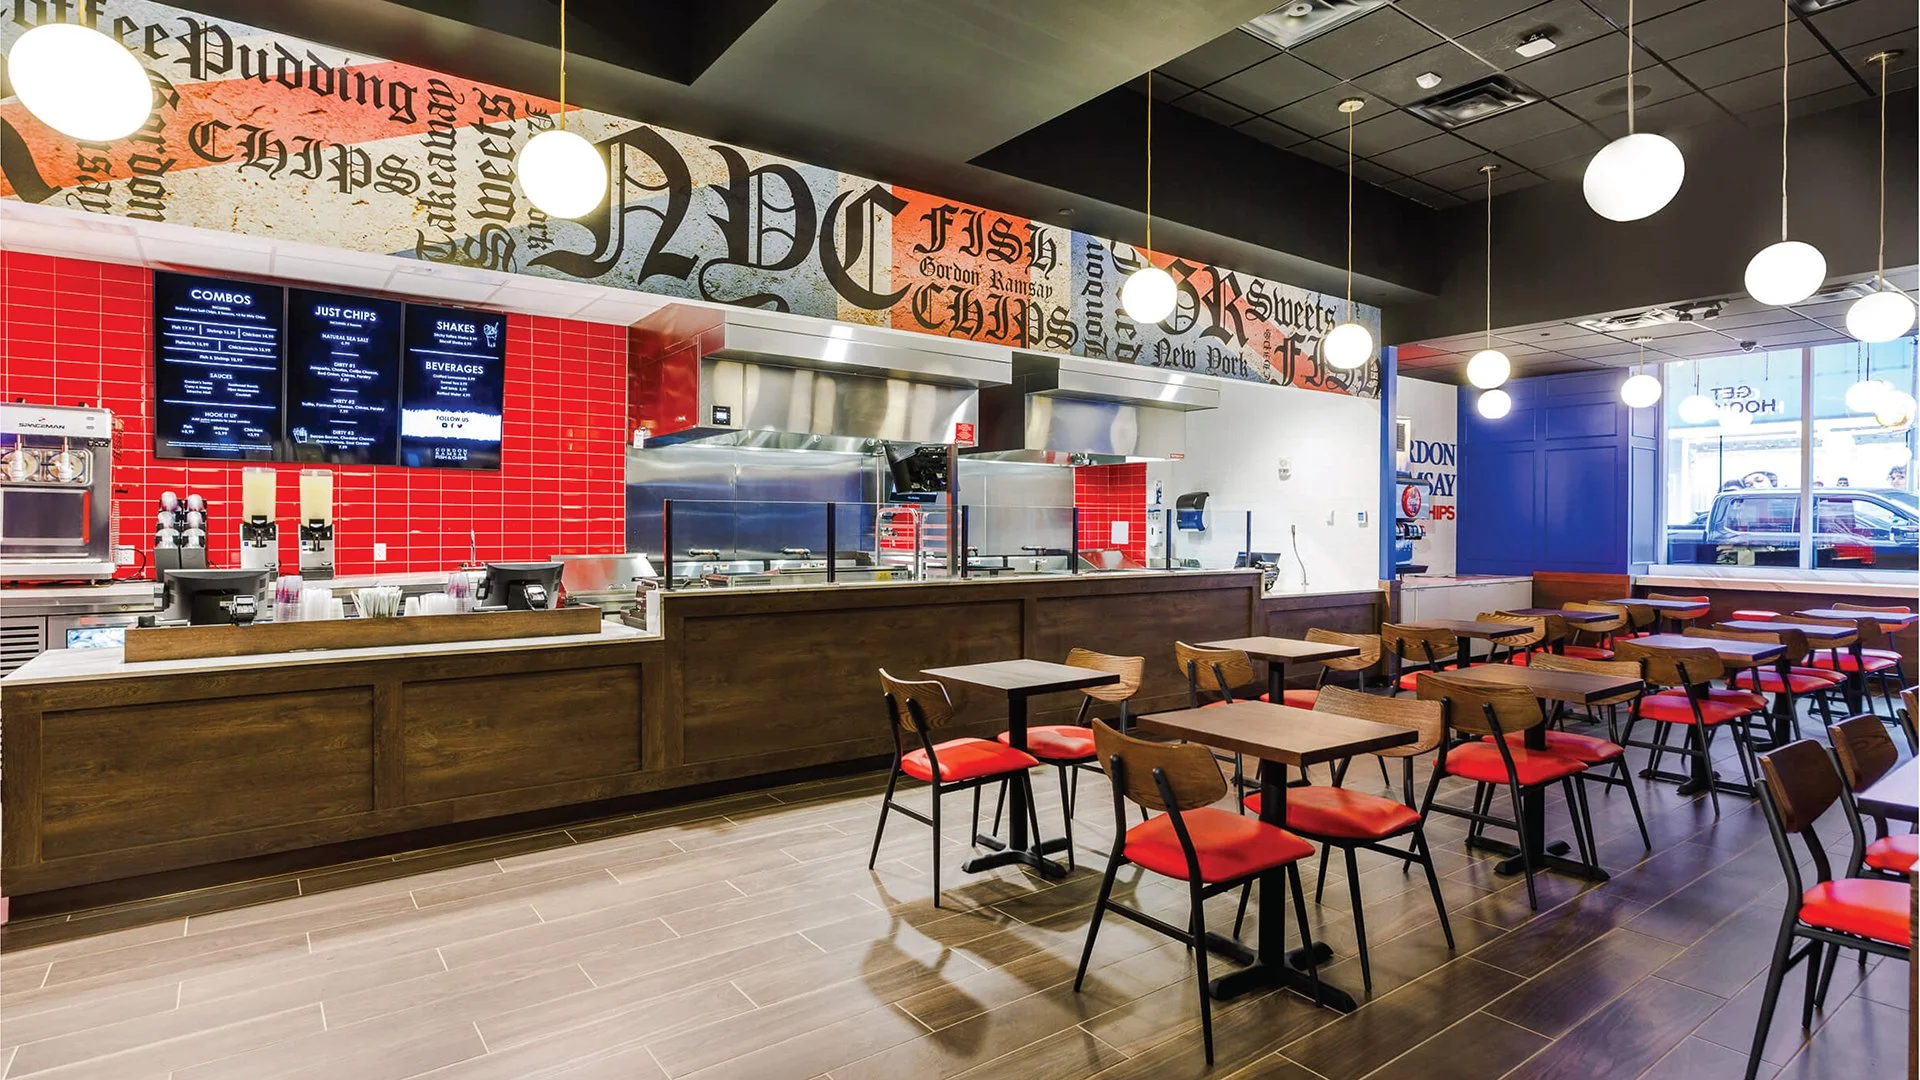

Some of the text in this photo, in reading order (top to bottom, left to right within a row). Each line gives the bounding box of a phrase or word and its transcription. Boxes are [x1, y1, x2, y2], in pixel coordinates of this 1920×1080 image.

[0, 0, 418, 124] offee Pudding
[187, 120, 421, 194] CHIPS
[416, 78, 464, 263] Takeaway
[462, 87, 517, 273] Sweets
[526, 125, 913, 313] NYC
[527, 207, 555, 250] ork
[913, 203, 1057, 280] FISH
[191, 290, 251, 305] COMBOS
[919, 256, 1053, 300] Gordon Ramsay
[1081, 241, 1109, 360] London
[1245, 276, 1337, 334] Sweets
[315, 306, 376, 321] JUST CHIPS
[437, 321, 475, 334] SHAKES
[912, 282, 1079, 350] CHIPS
[426, 361, 484, 374] BEVERAGES
[1151, 337, 1249, 378] New York
[1410, 472, 1456, 496] SAY
